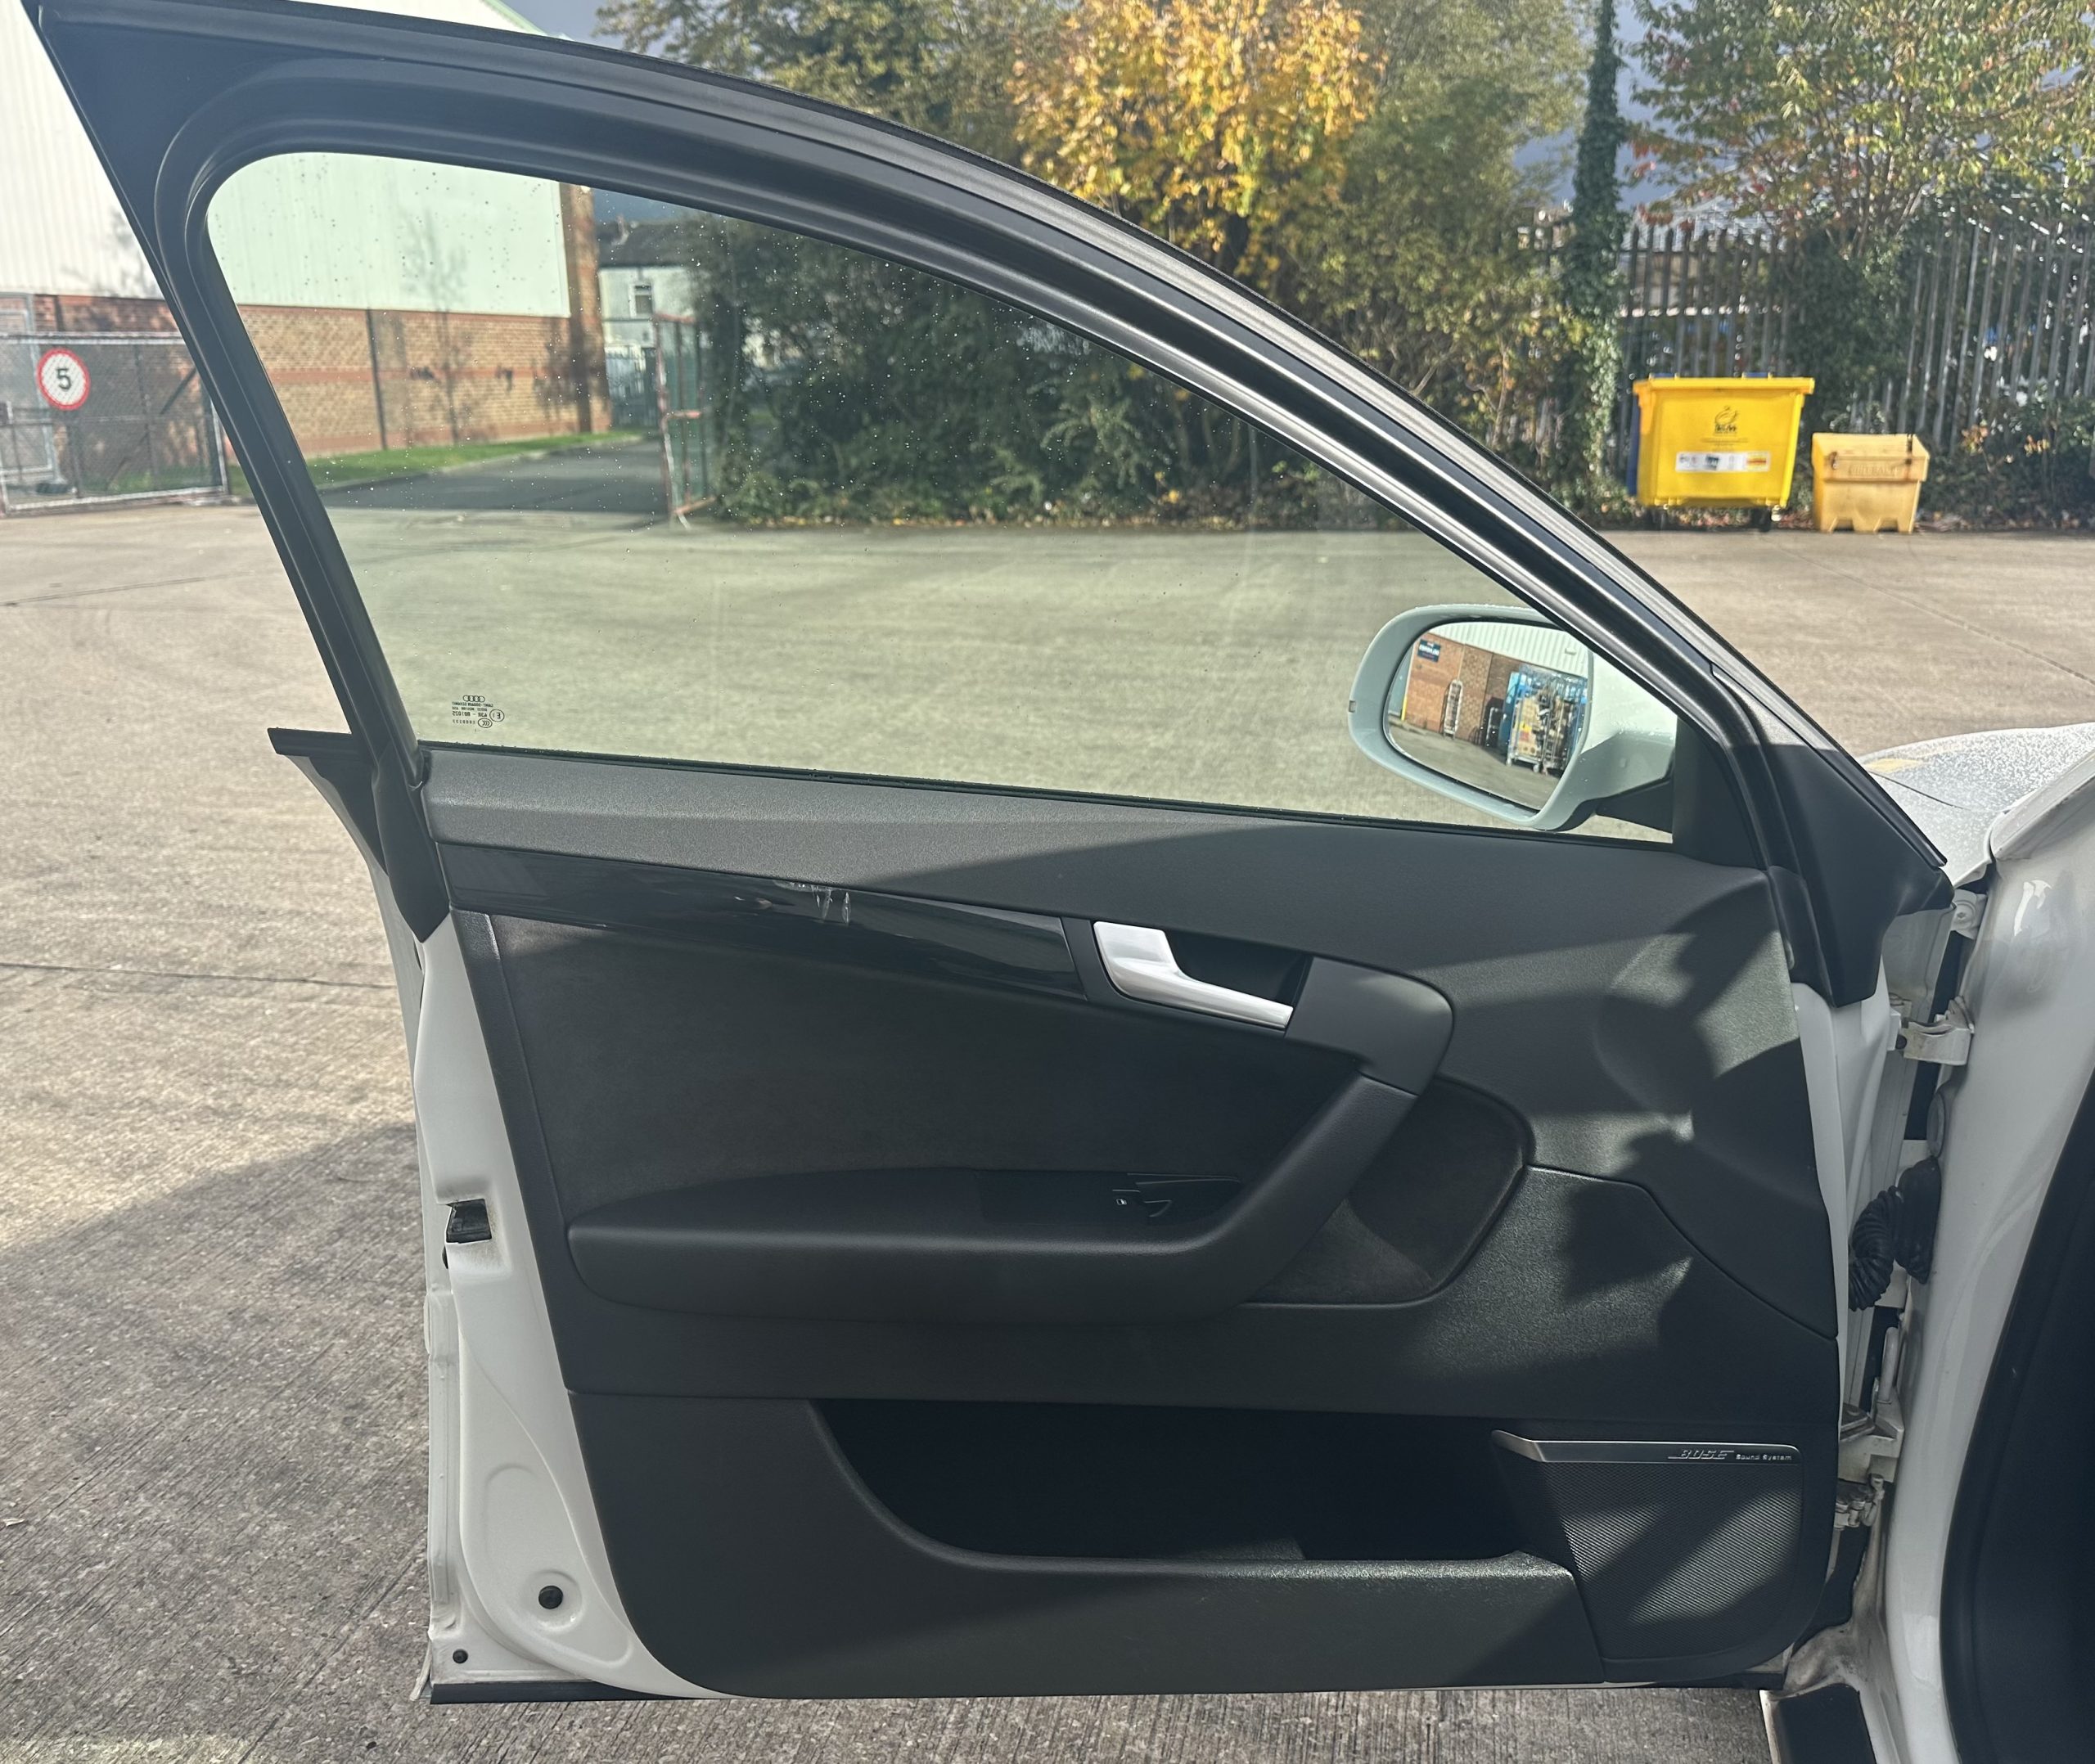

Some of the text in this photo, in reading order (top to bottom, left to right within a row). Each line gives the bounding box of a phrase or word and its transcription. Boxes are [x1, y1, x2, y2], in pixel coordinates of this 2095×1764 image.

[56, 367, 71, 390] 5
[1668, 1449, 1734, 1460] BOSE
[1762, 1453, 1792, 1461] System
